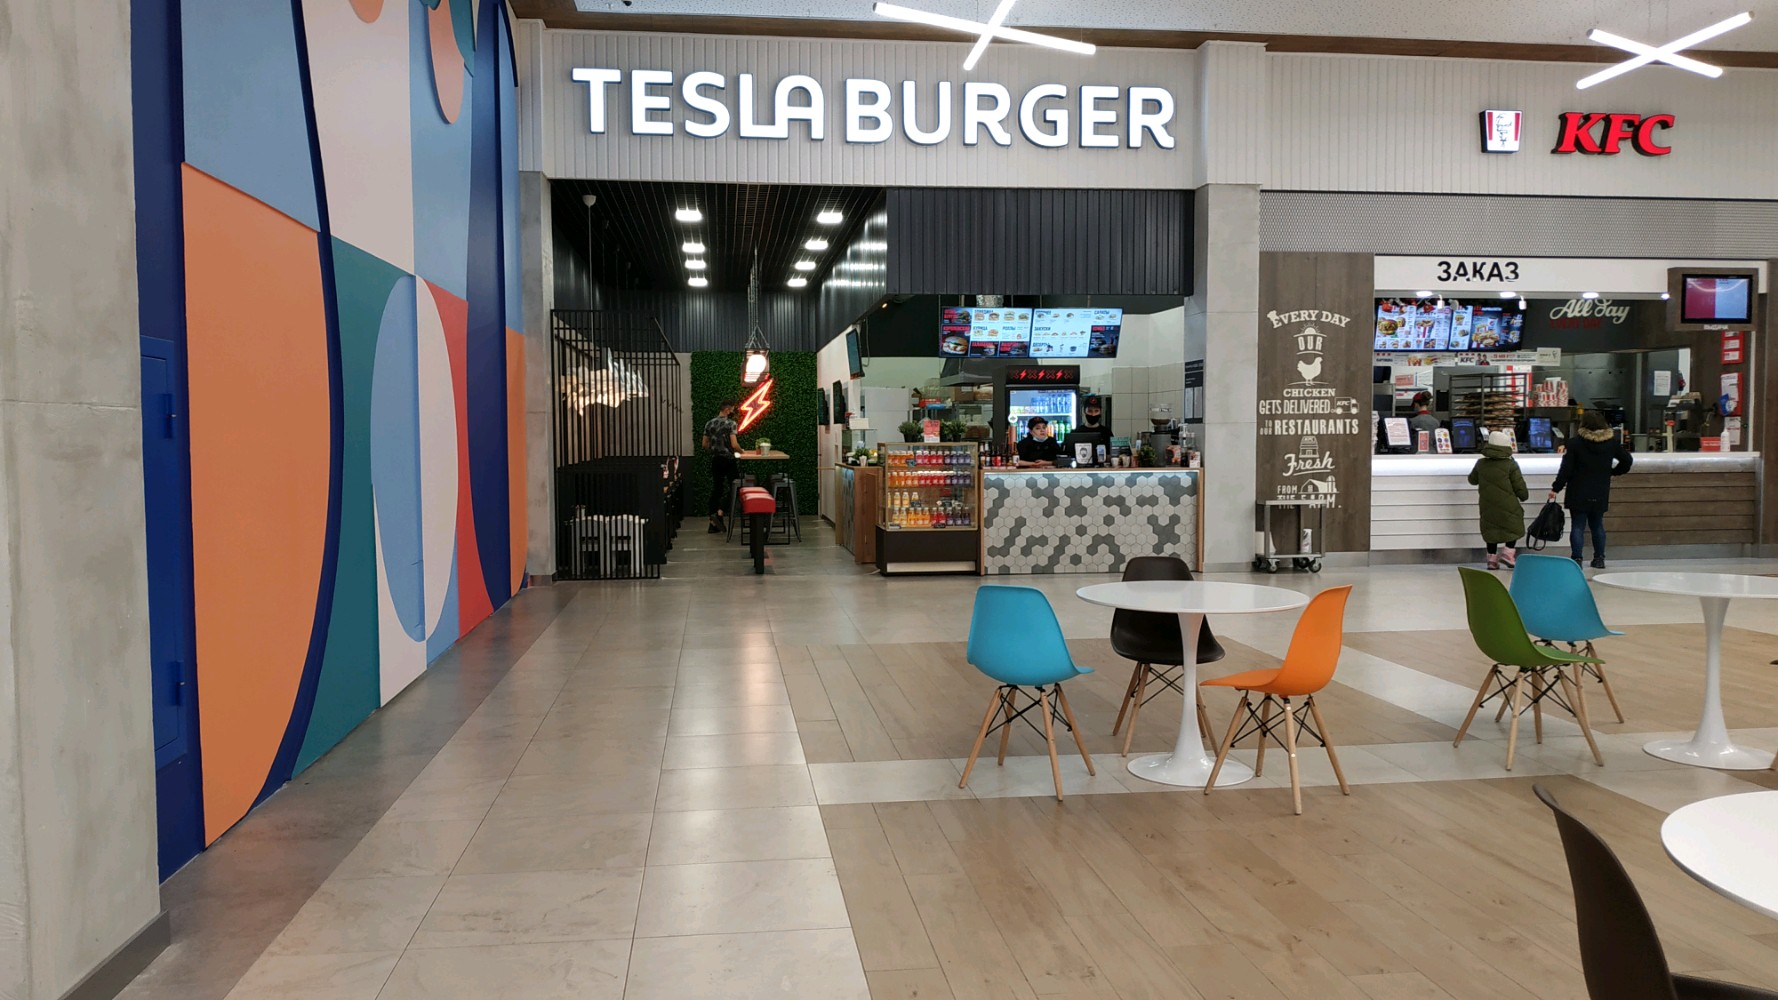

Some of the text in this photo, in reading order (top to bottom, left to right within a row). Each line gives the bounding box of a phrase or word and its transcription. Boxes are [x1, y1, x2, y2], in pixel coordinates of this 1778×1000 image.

[571, 66, 1176, 150] TESLA BURGER
[1552, 111, 1675, 155] KFC
[1437, 260, 1520, 283] ЗАКАЗ
[1549, 299, 1593, 320] All
[1269, 310, 1351, 329] EVERY DAY
[1297, 336, 1324, 351] OUR
[1283, 388, 1336, 397] CHICKEN
[1259, 399, 1331, 415] GETS DELIVERED
[1260, 419, 1360, 435] OUR RESTAURANTS
[1282, 450, 1336, 477] Fresh
[1277, 484, 1298, 494] FROM
